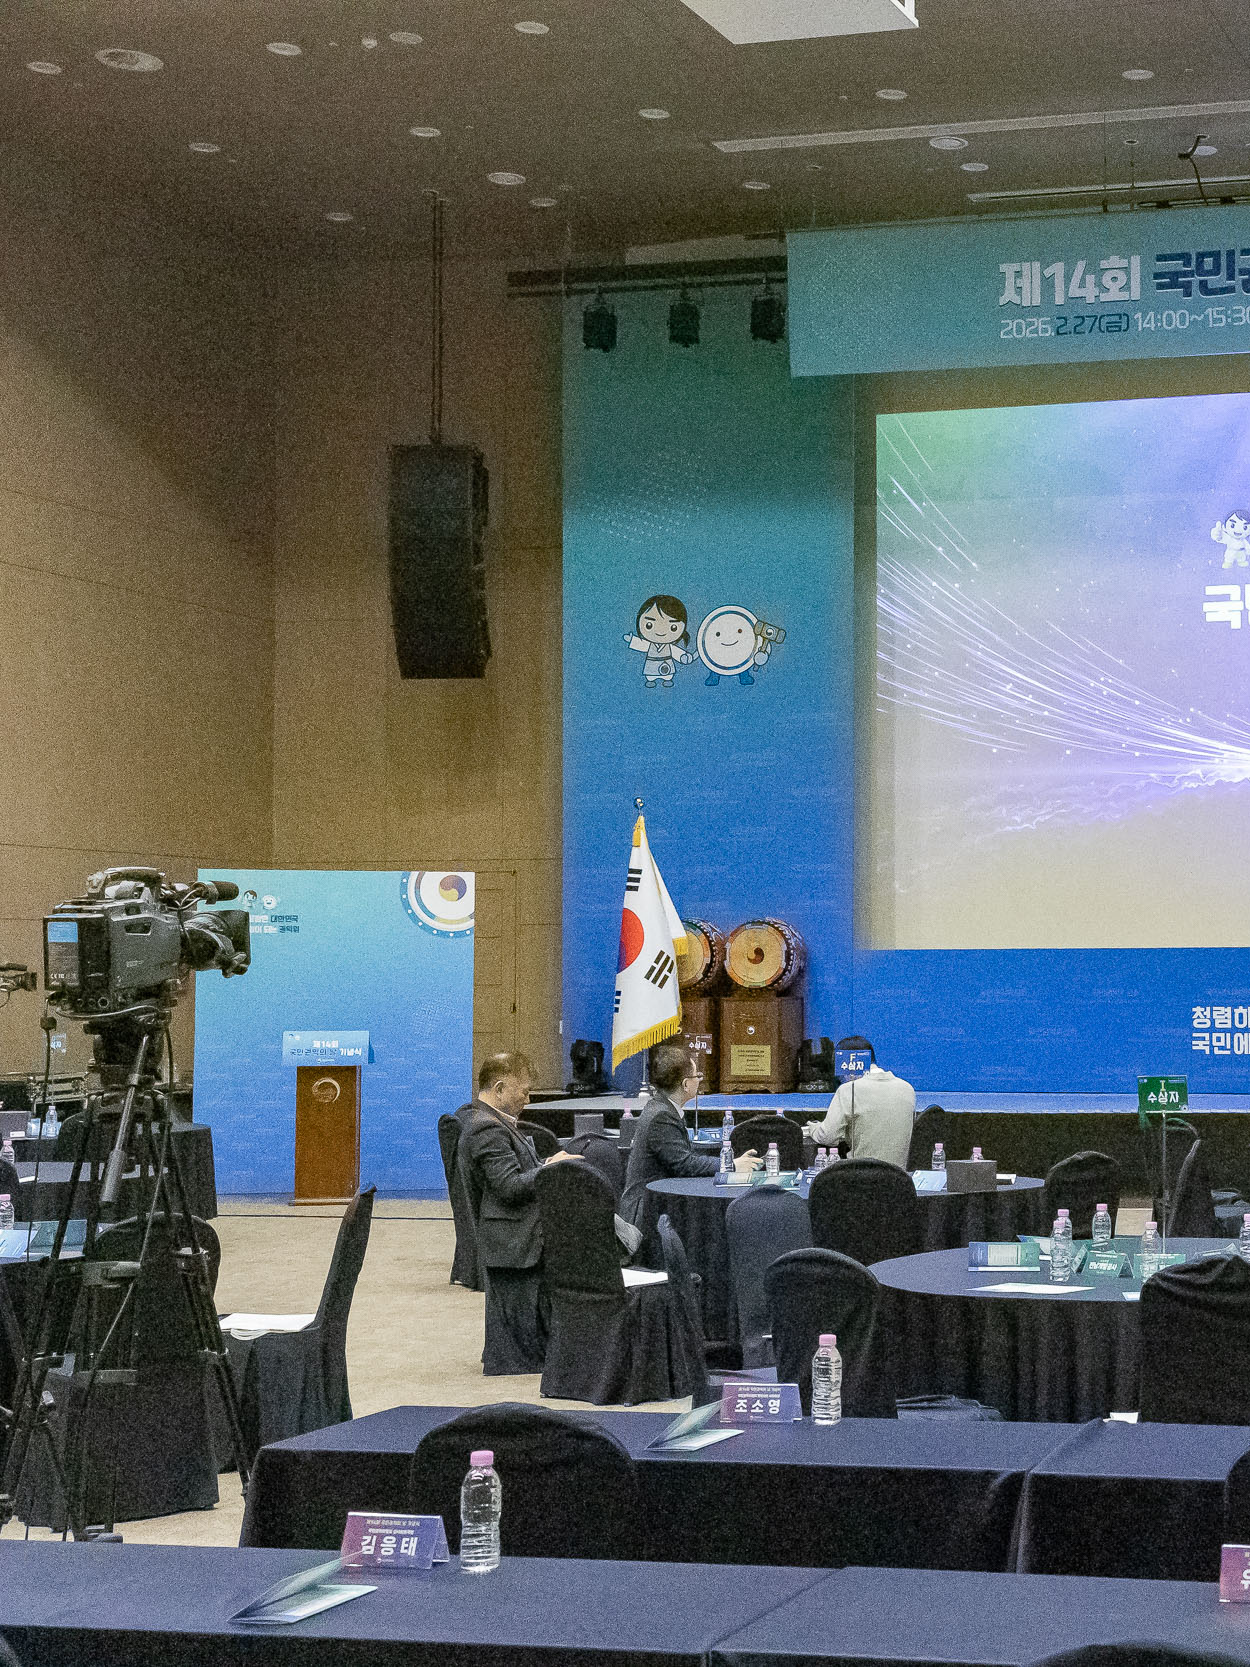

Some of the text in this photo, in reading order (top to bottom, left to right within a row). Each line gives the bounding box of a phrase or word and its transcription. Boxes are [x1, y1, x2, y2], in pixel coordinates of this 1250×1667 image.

[999, 255, 1141, 307] 제14회
[313, 1040, 339, 1048] 제14회
[689, 1041, 707, 1049] 수상자
[339, 1047, 362, 1056] 기념식
[850, 1053, 856, 1062] F
[841, 1061, 864, 1070] 수상자
[1147, 1091, 1179, 1104] 수상자
[735, 1399, 780, 1414] 조소영
[361, 1535, 418, 1557] 김응태
